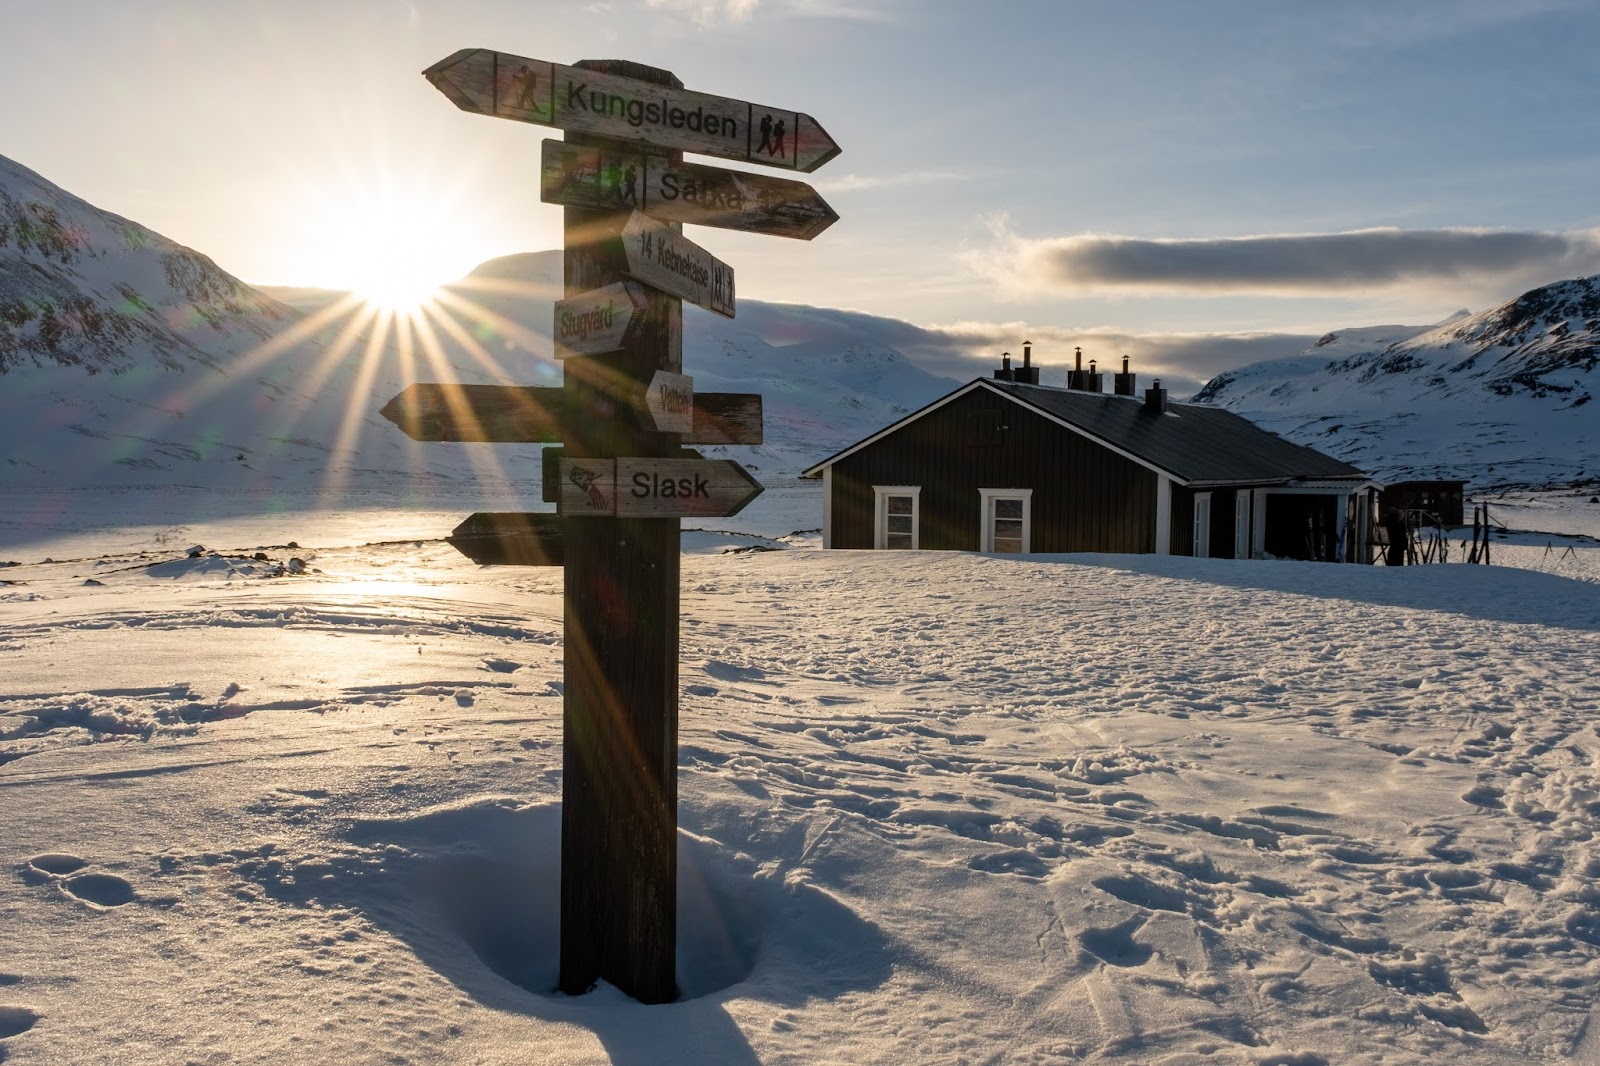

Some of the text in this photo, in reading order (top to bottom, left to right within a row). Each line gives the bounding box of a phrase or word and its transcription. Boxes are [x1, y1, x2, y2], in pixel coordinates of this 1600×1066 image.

[567, 81, 737, 139] Kungsleden
[641, 229, 653, 260] 14
[631, 471, 710, 499] Slask
